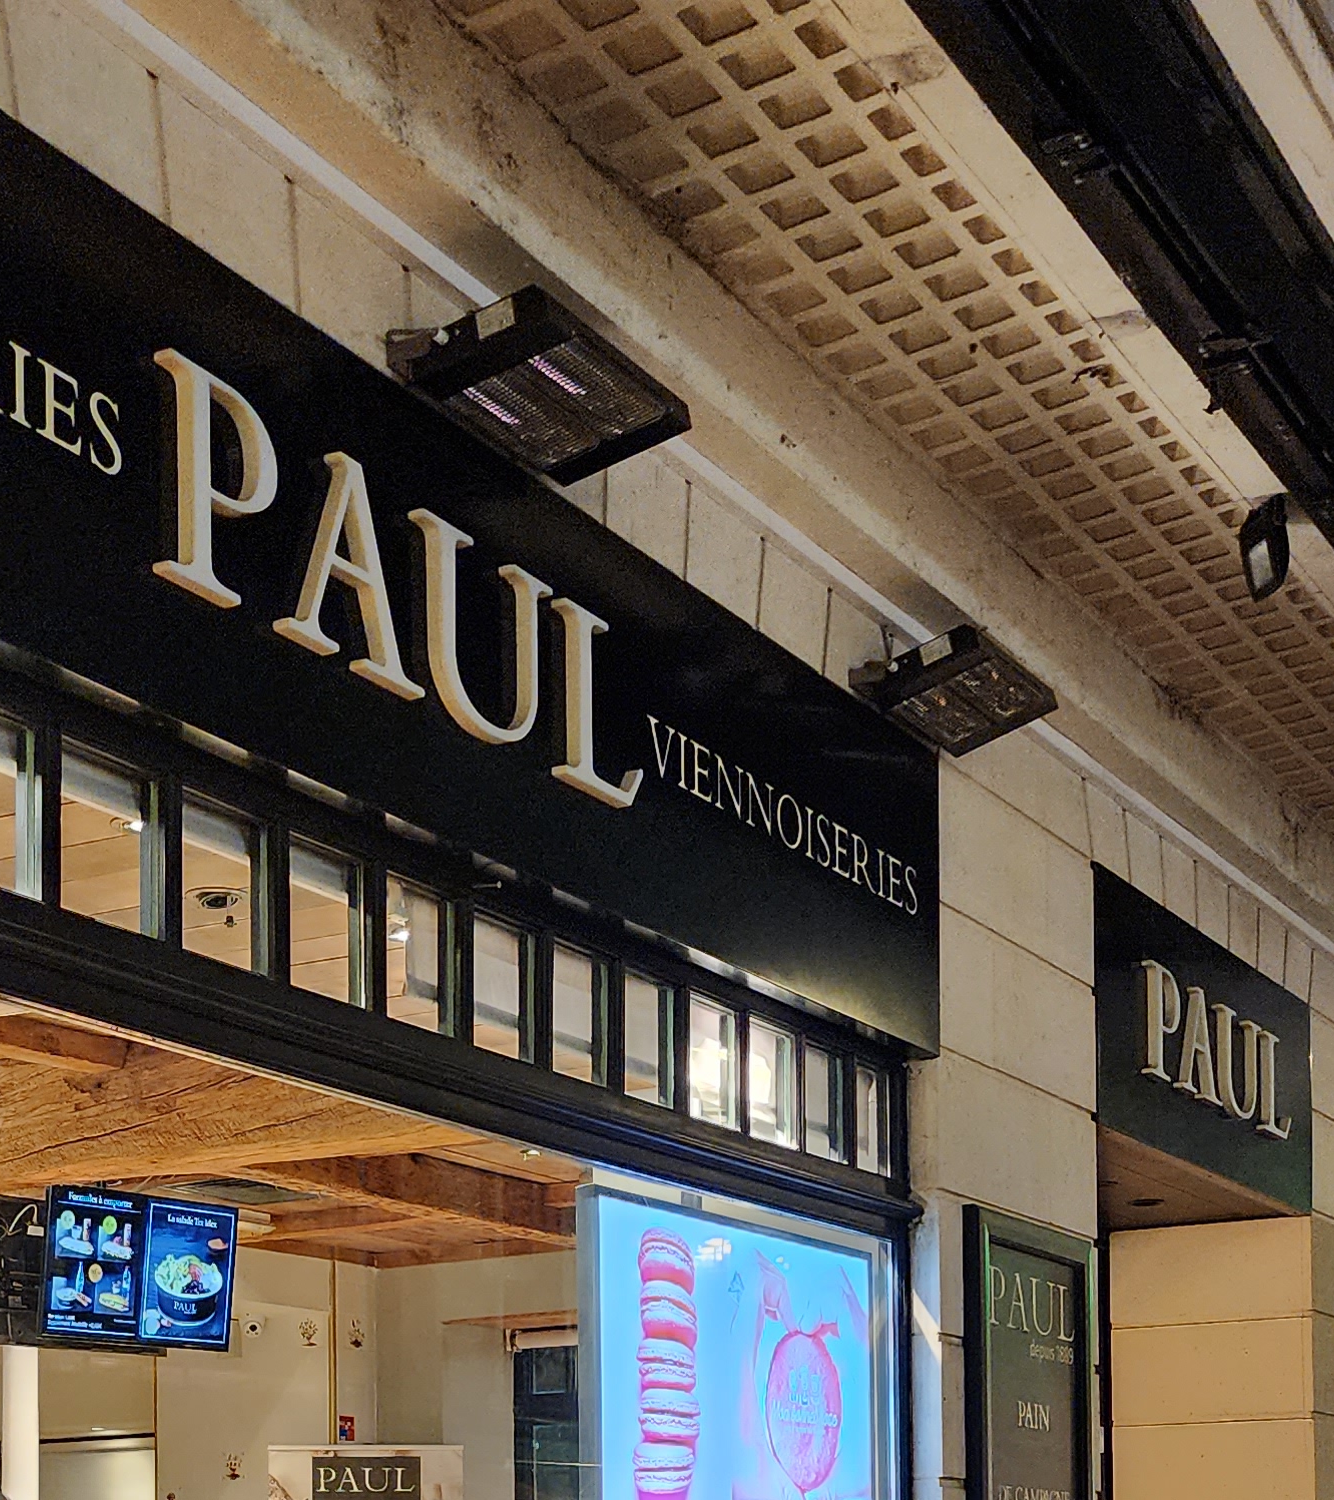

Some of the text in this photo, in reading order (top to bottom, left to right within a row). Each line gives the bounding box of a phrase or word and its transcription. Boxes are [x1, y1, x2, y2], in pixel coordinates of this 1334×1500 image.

[153, 348, 644, 808] PAUL
[645, 715, 919, 916] VIENNOISERIES
[1139, 959, 1292, 1139] PAUL
[173, 1300, 198, 1313] PAUL
[989, 1264, 1075, 1343] PAUL
[1017, 1400, 1050, 1432] PAIN
[315, 1466, 416, 1493] PAUL
